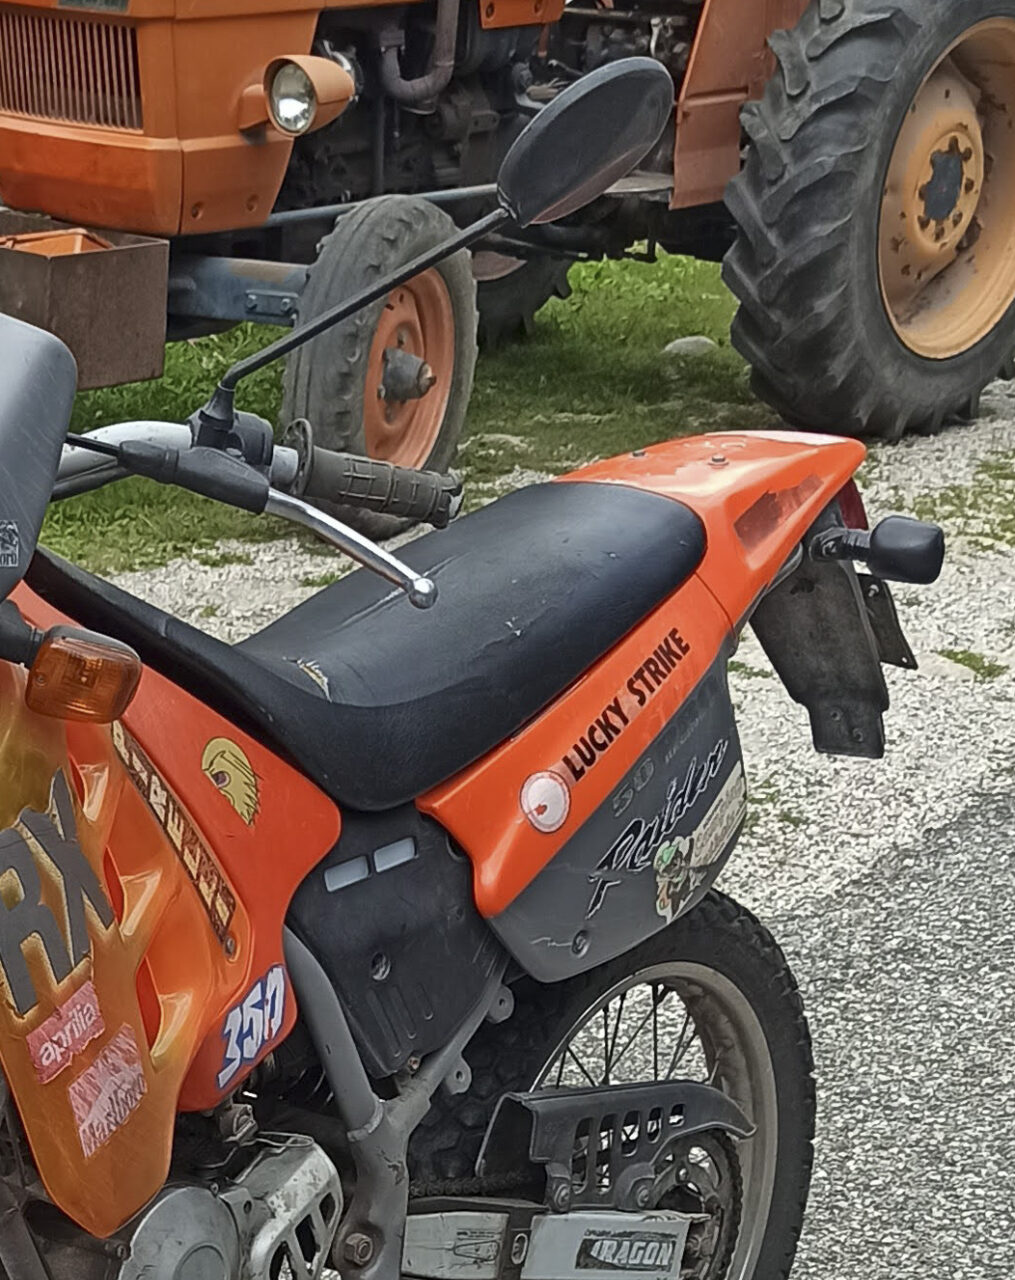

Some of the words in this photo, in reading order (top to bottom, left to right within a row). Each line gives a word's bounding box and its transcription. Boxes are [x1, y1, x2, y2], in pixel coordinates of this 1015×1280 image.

[562, 697, 629, 782] LUCKY
[627, 627, 691, 706] STRIKE
[39, 1002, 97, 1067] aprilia
[215, 964, 286, 1091] 350
